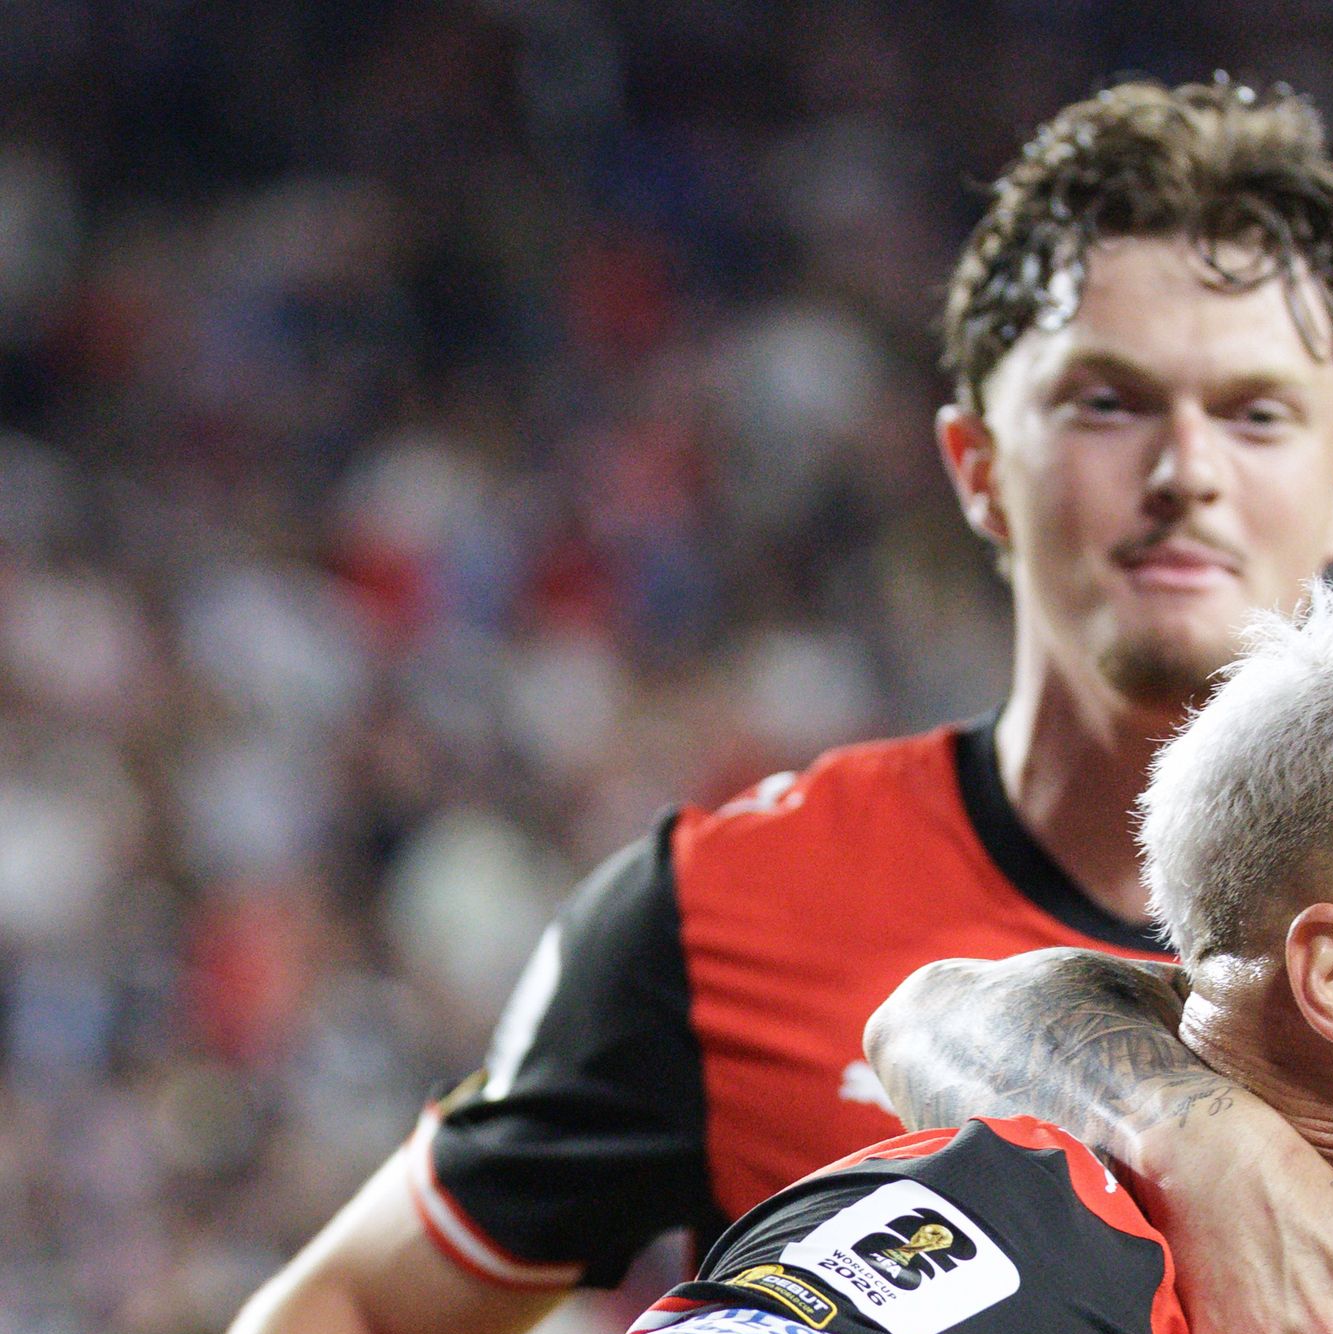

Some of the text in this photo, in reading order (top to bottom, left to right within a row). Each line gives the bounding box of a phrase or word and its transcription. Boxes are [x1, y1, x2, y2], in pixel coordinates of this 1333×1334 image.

[762, 1275, 829, 1311] DEBUT
[817, 1258, 887, 1306] 2026
[832, 1249, 897, 1300] WORLD CUP
